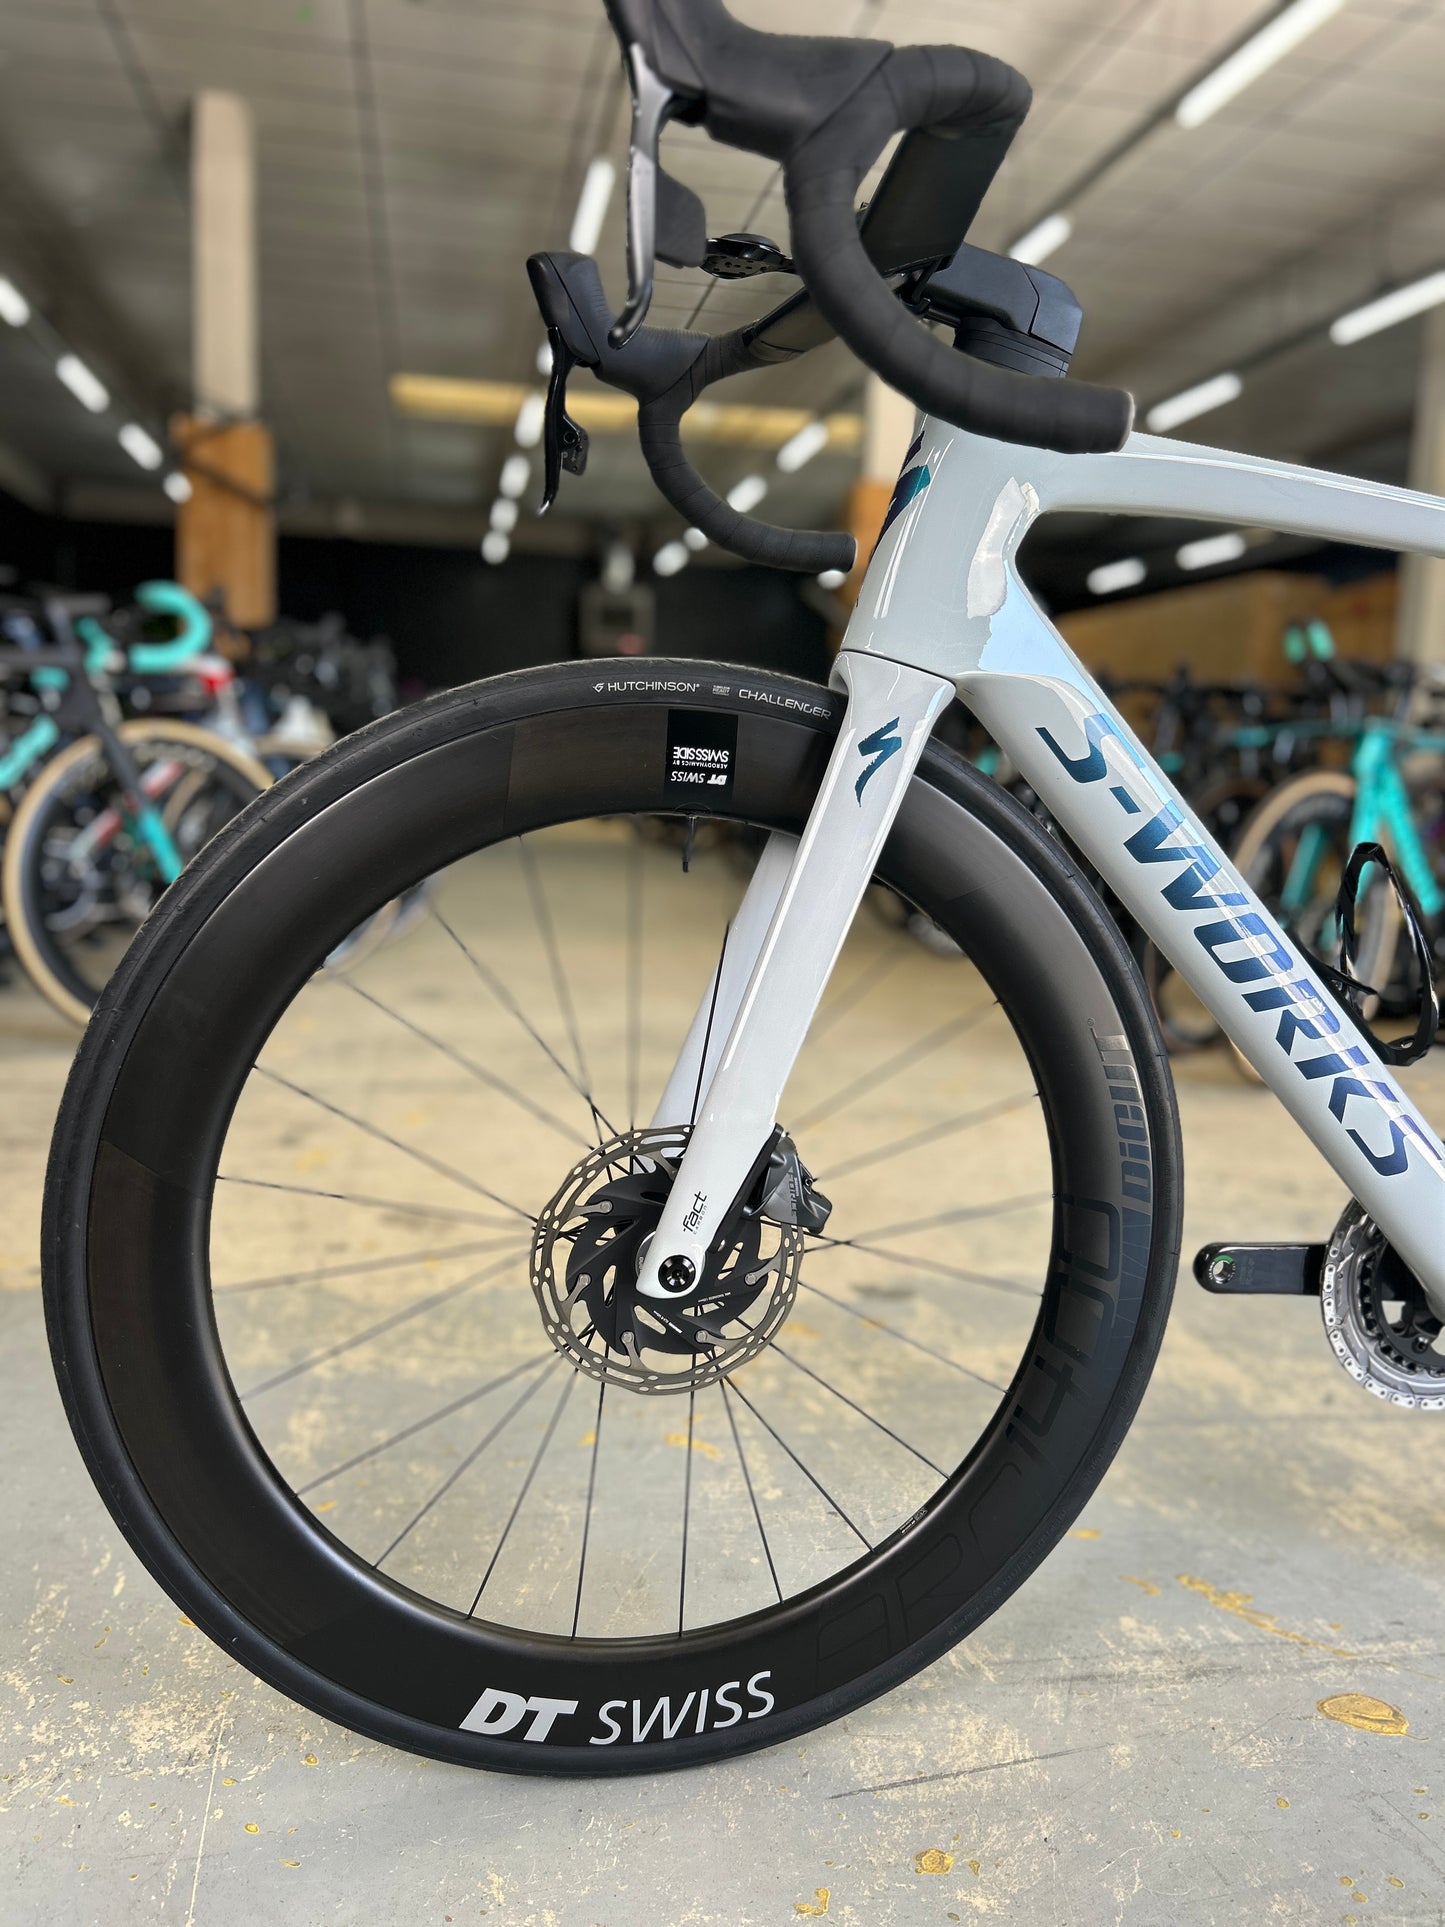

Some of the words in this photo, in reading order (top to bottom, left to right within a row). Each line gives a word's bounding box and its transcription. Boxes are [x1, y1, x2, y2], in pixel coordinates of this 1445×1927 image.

[738, 688, 832, 720] CHALLENGER
[670, 771, 706, 783] SWISS
[682, 760, 728, 769] AERODYNAMICS
[706, 774, 728, 785] DT
[1035, 712, 1443, 1177] S-WORKS
[682, 1190, 707, 1232] fact
[458, 1687, 579, 1743] DT
[588, 1670, 775, 1745] SWISS
